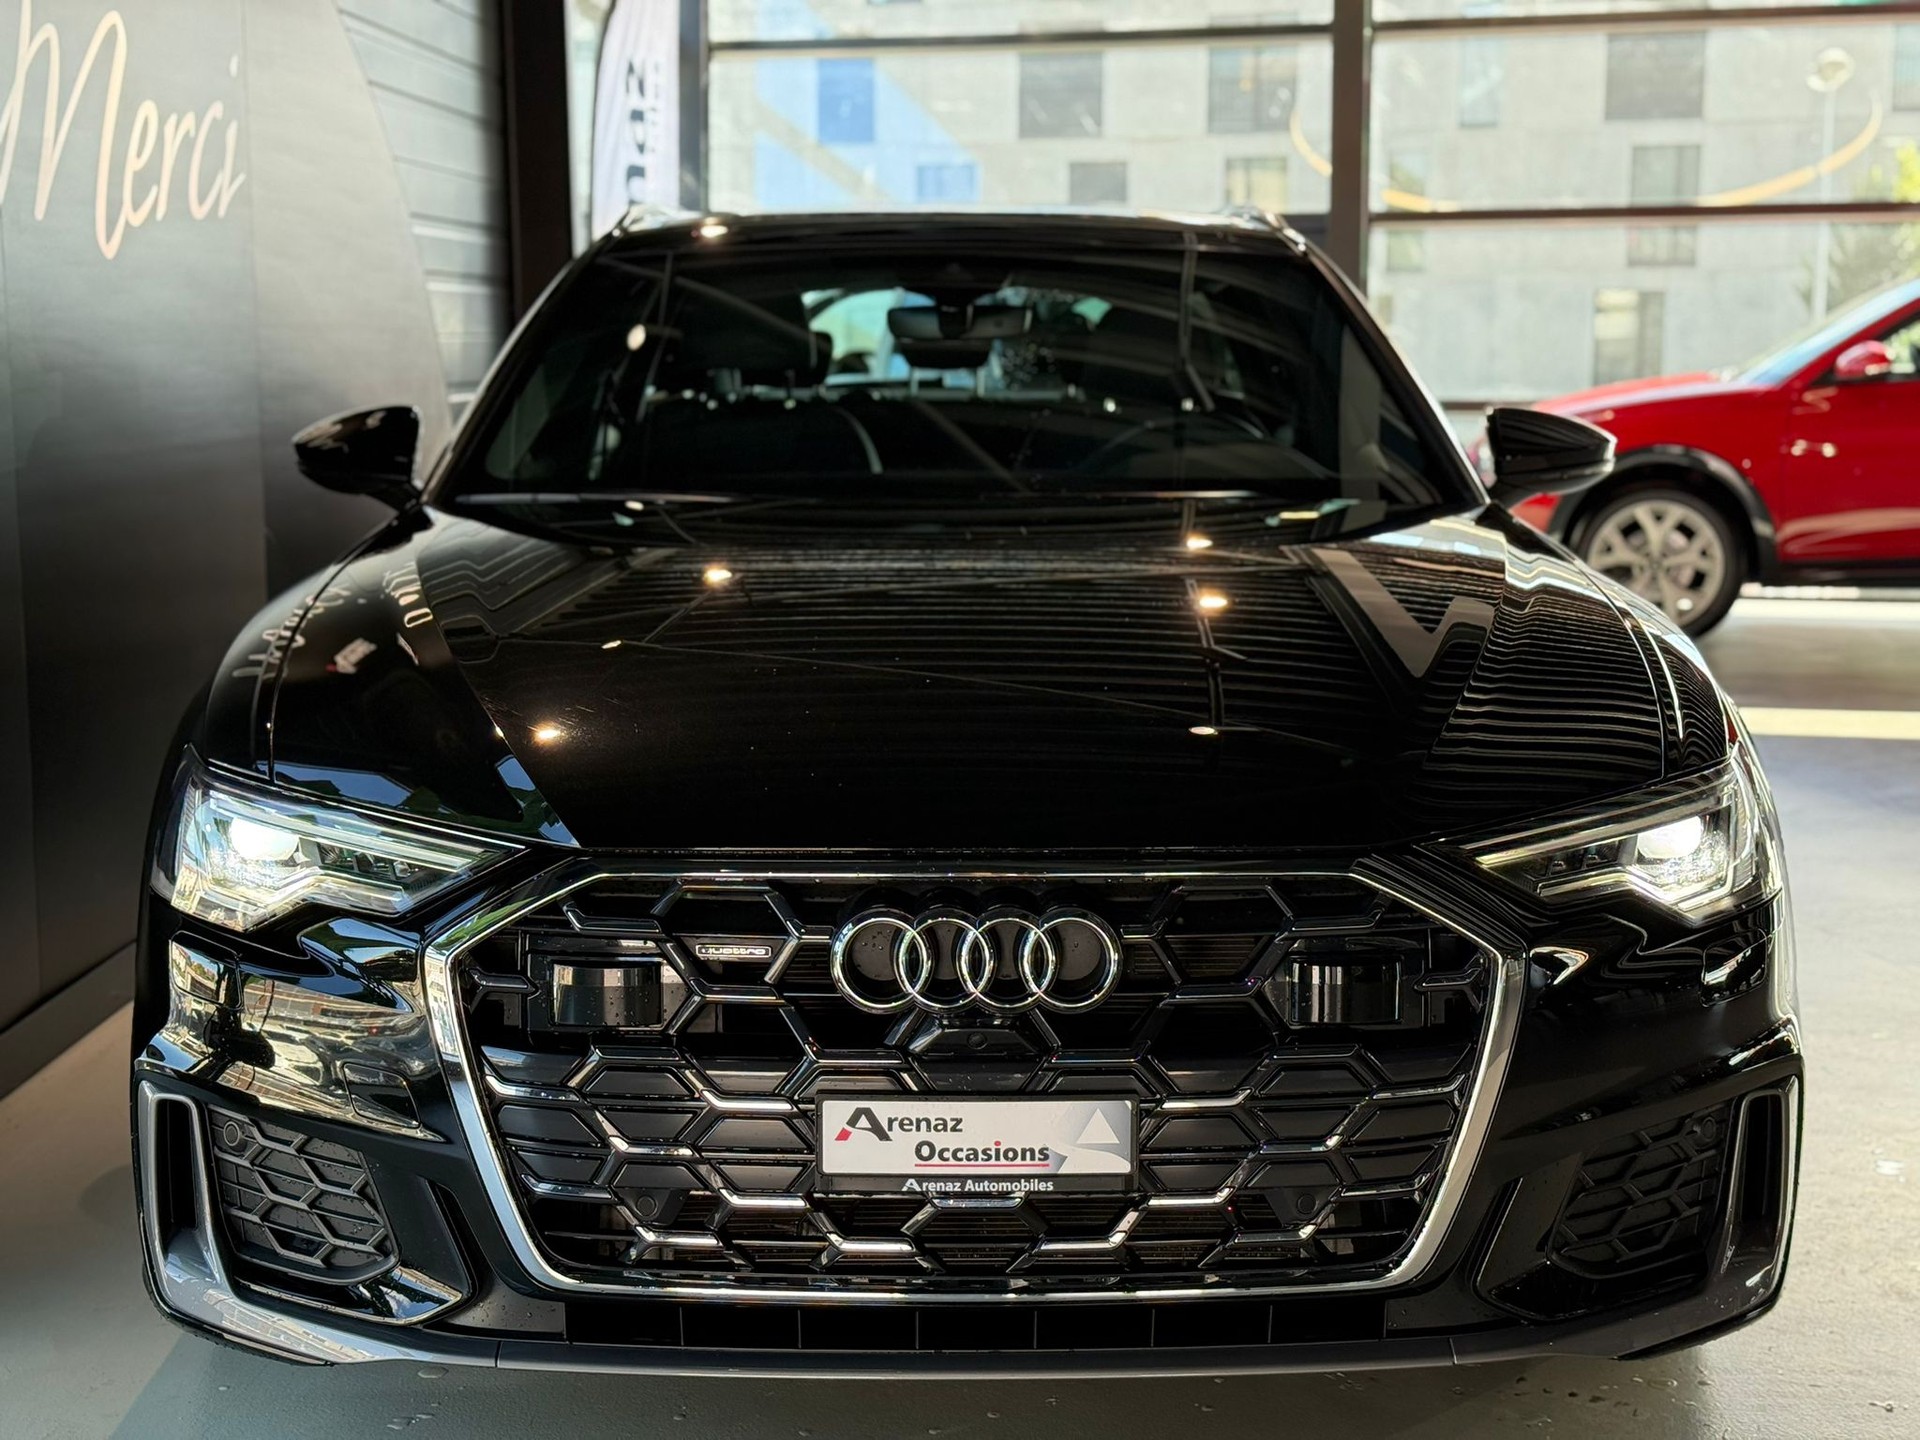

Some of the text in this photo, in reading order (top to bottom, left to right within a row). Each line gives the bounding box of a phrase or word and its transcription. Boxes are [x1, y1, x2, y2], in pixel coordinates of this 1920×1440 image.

[0, 0, 246, 260] Merci
[700, 946, 767, 956] quattro
[834, 1107, 963, 1142] Arenaz
[915, 1140, 1049, 1162] Occasions
[902, 1178, 1053, 1192] Arenaz Automobiles
